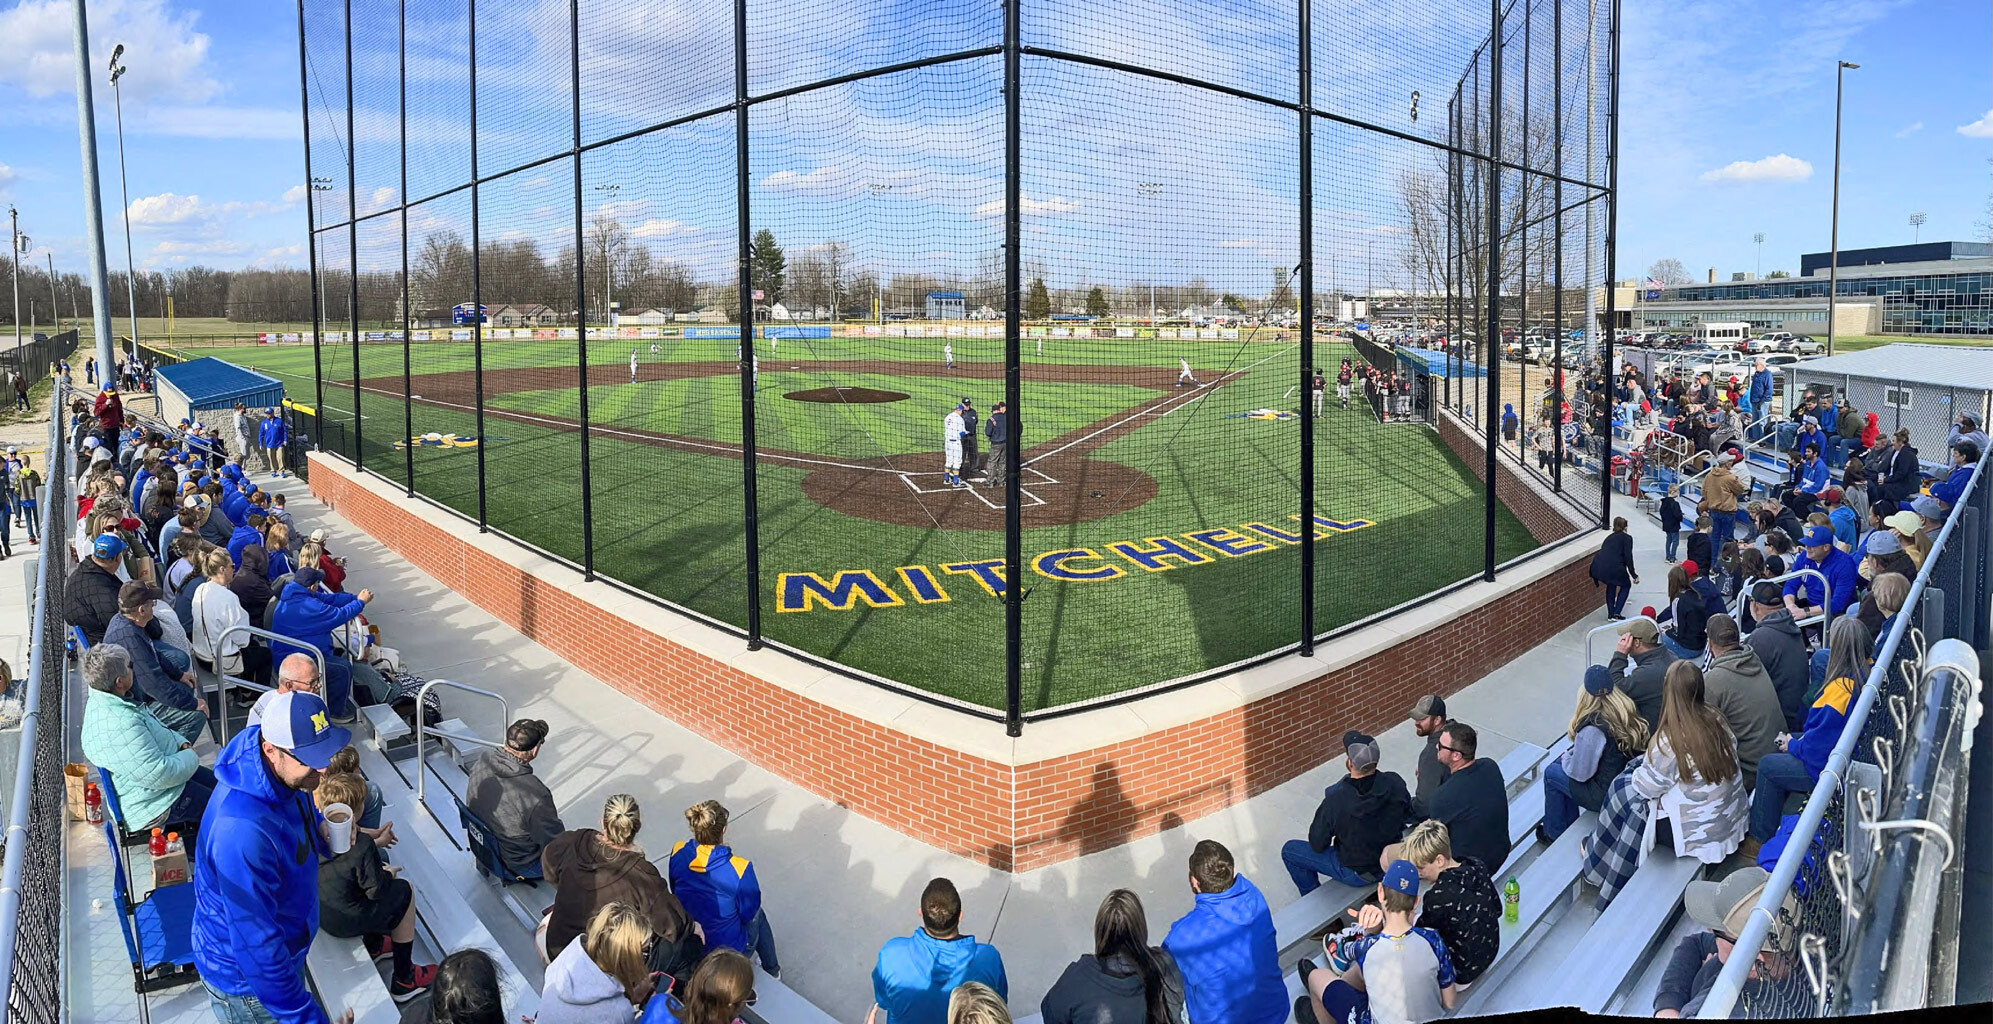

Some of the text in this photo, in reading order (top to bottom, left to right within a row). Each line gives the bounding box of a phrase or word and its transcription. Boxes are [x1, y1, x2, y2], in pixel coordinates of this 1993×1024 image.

[776, 513, 1377, 613] MITCHELL
[310, 710, 329, 732] M
[160, 868, 184, 881] ACE
